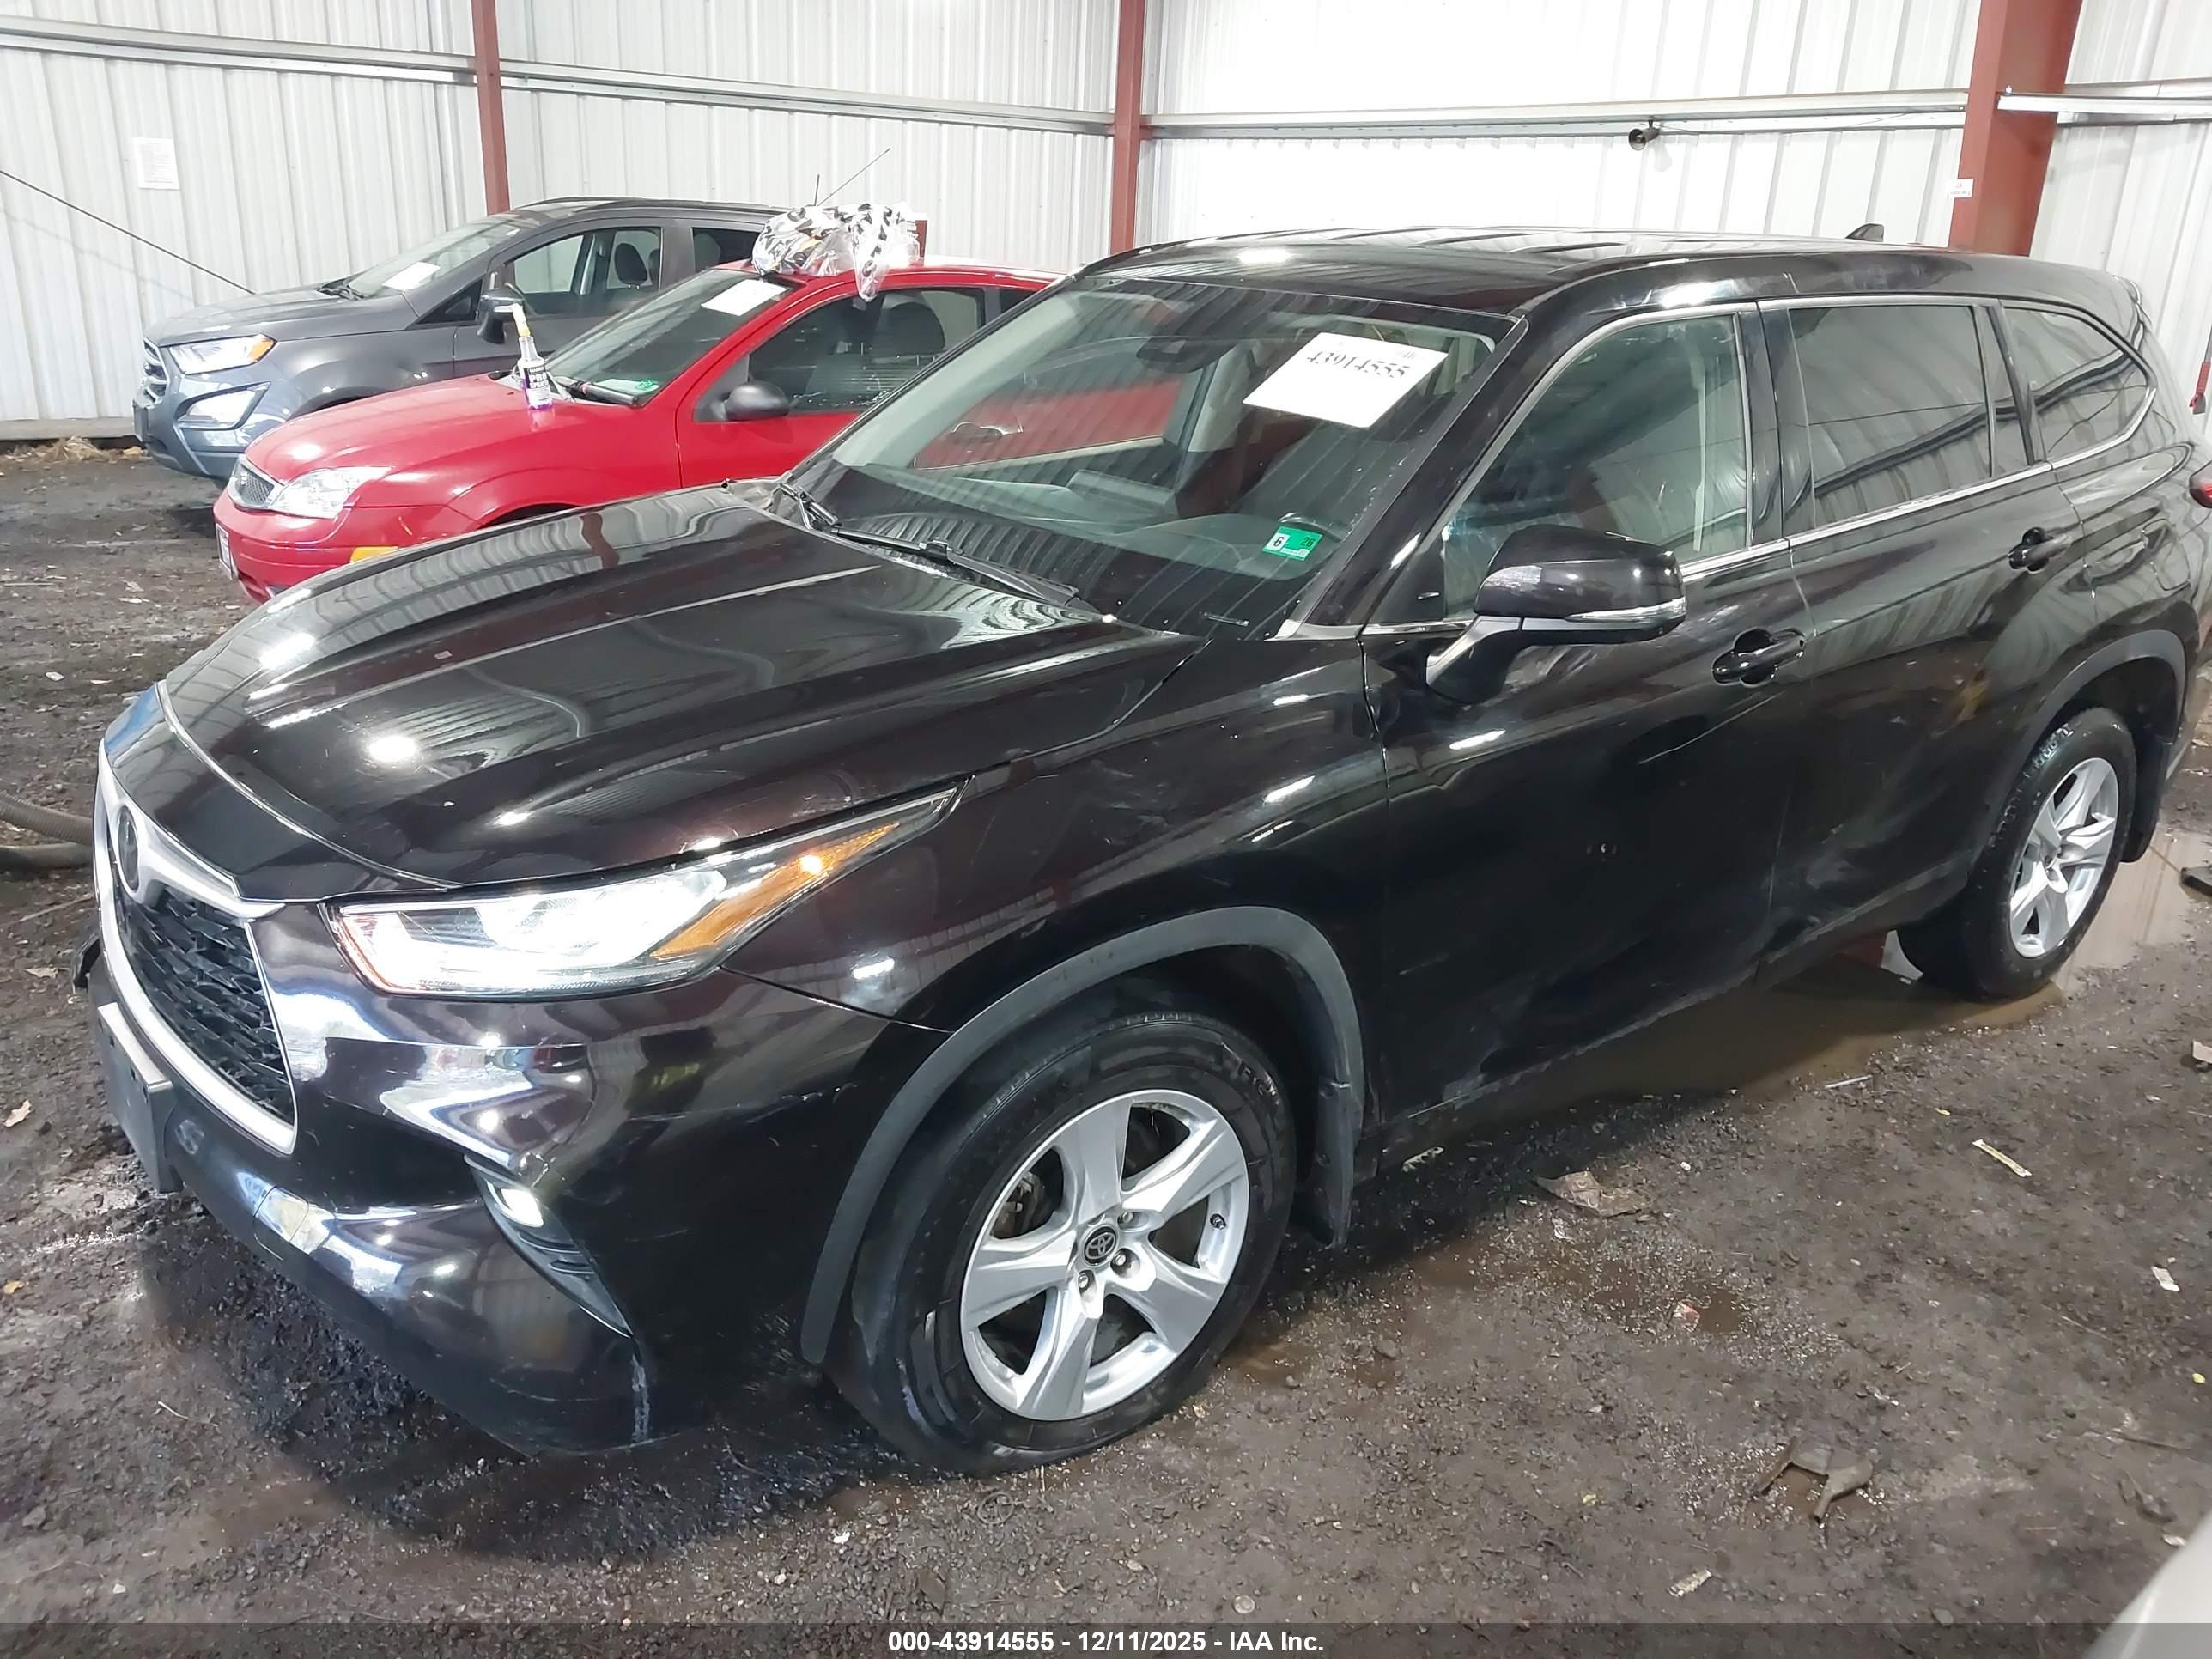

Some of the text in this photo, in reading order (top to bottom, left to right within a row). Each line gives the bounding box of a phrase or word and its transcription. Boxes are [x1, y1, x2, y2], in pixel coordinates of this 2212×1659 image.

[1306, 350, 1411, 378] 43914555
[1273, 536, 1316, 548] 6 26
